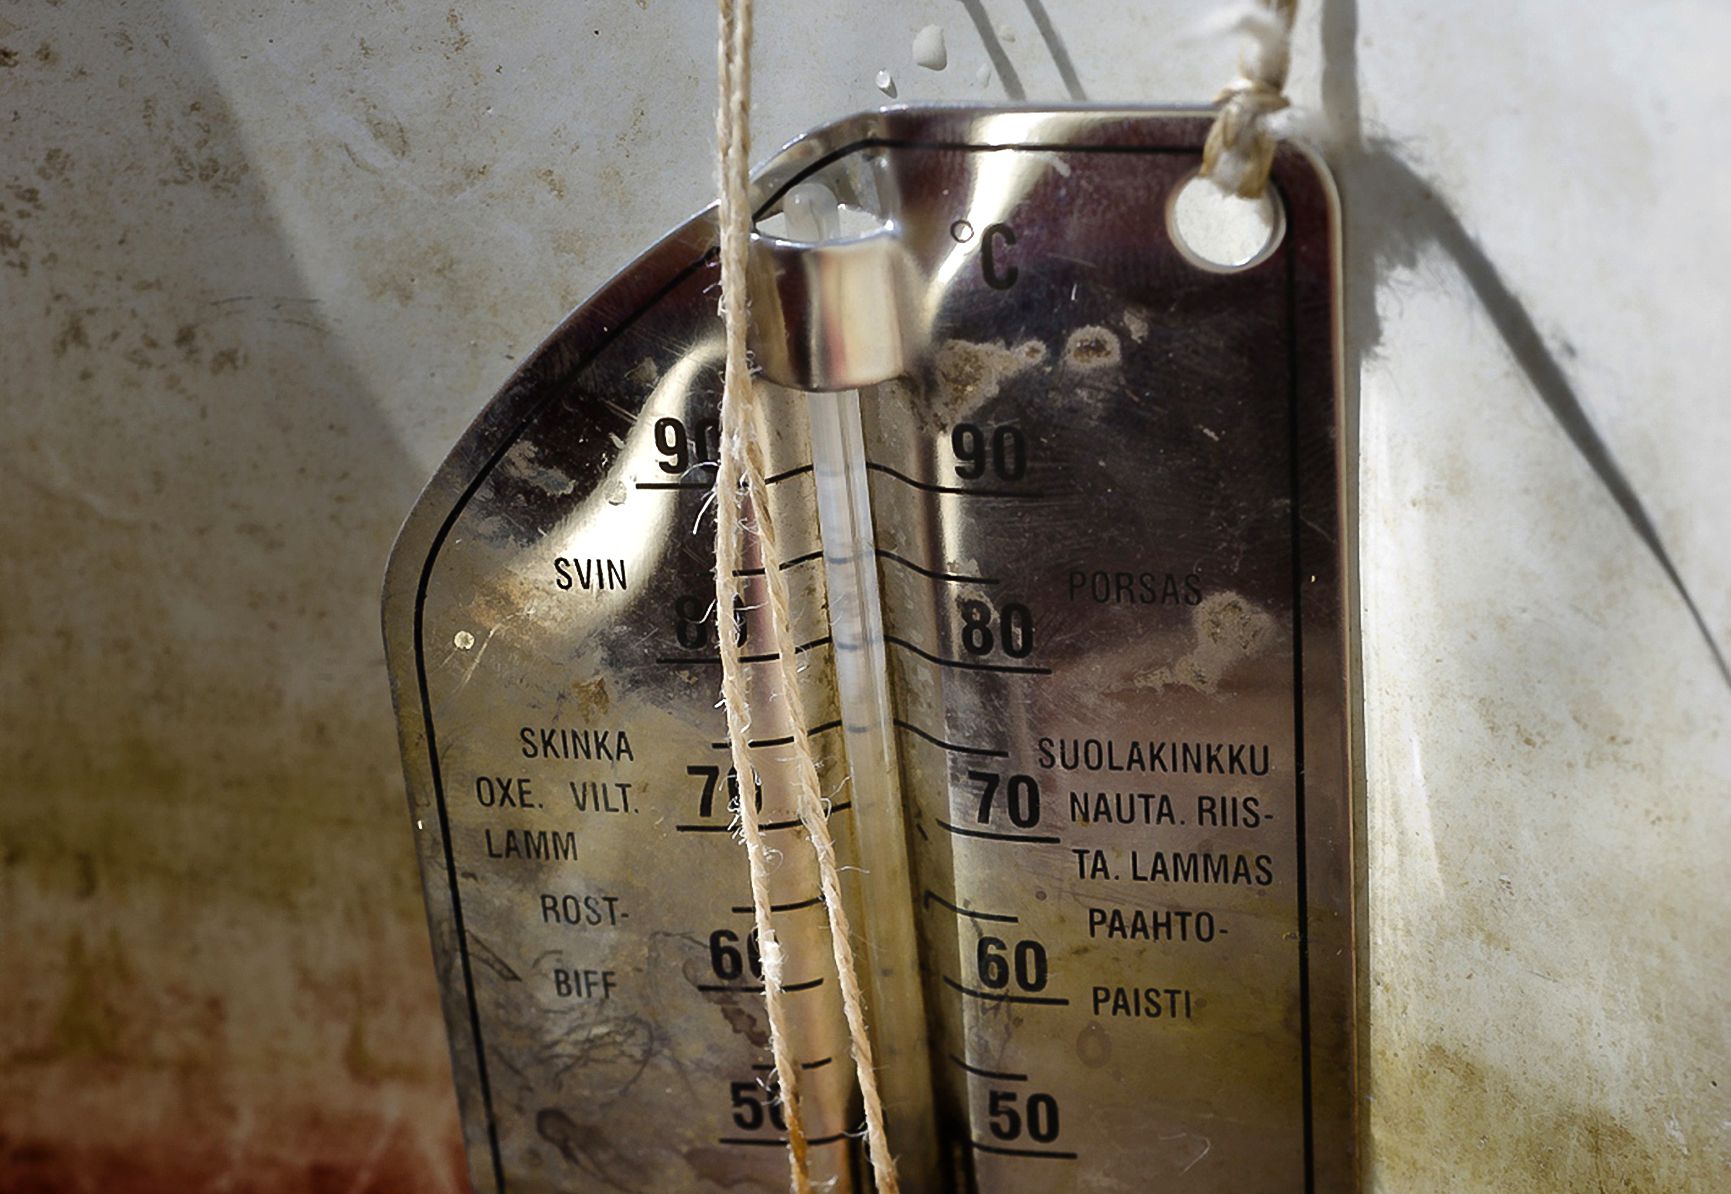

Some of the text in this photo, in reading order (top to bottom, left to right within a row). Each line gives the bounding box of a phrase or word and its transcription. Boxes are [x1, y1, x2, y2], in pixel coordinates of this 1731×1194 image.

[951, 421, 1029, 483] 90
[553, 556, 628, 591] SVIN
[1068, 568, 1204, 607] PORSAS
[960, 599, 1035, 660] 80
[520, 726, 635, 763] SKINKA
[1037, 736, 1271, 777] SUOLAKINKKU
[475, 776, 640, 815] OXE. VILT.
[967, 769, 1042, 830] 70
[1068, 790, 1275, 830] NAUTA. RIIS-
[484, 828, 579, 862] LAMM
[1071, 847, 1274, 886] TA. LAMMAS
[540, 893, 629, 927] ROST-
[1087, 907, 1230, 944] PAAHTO-
[553, 967, 618, 1000] BIFF
[975, 935, 1049, 993] 60
[1091, 985, 1193, 1020] PAISTI
[987, 1090, 1061, 1145] 50
